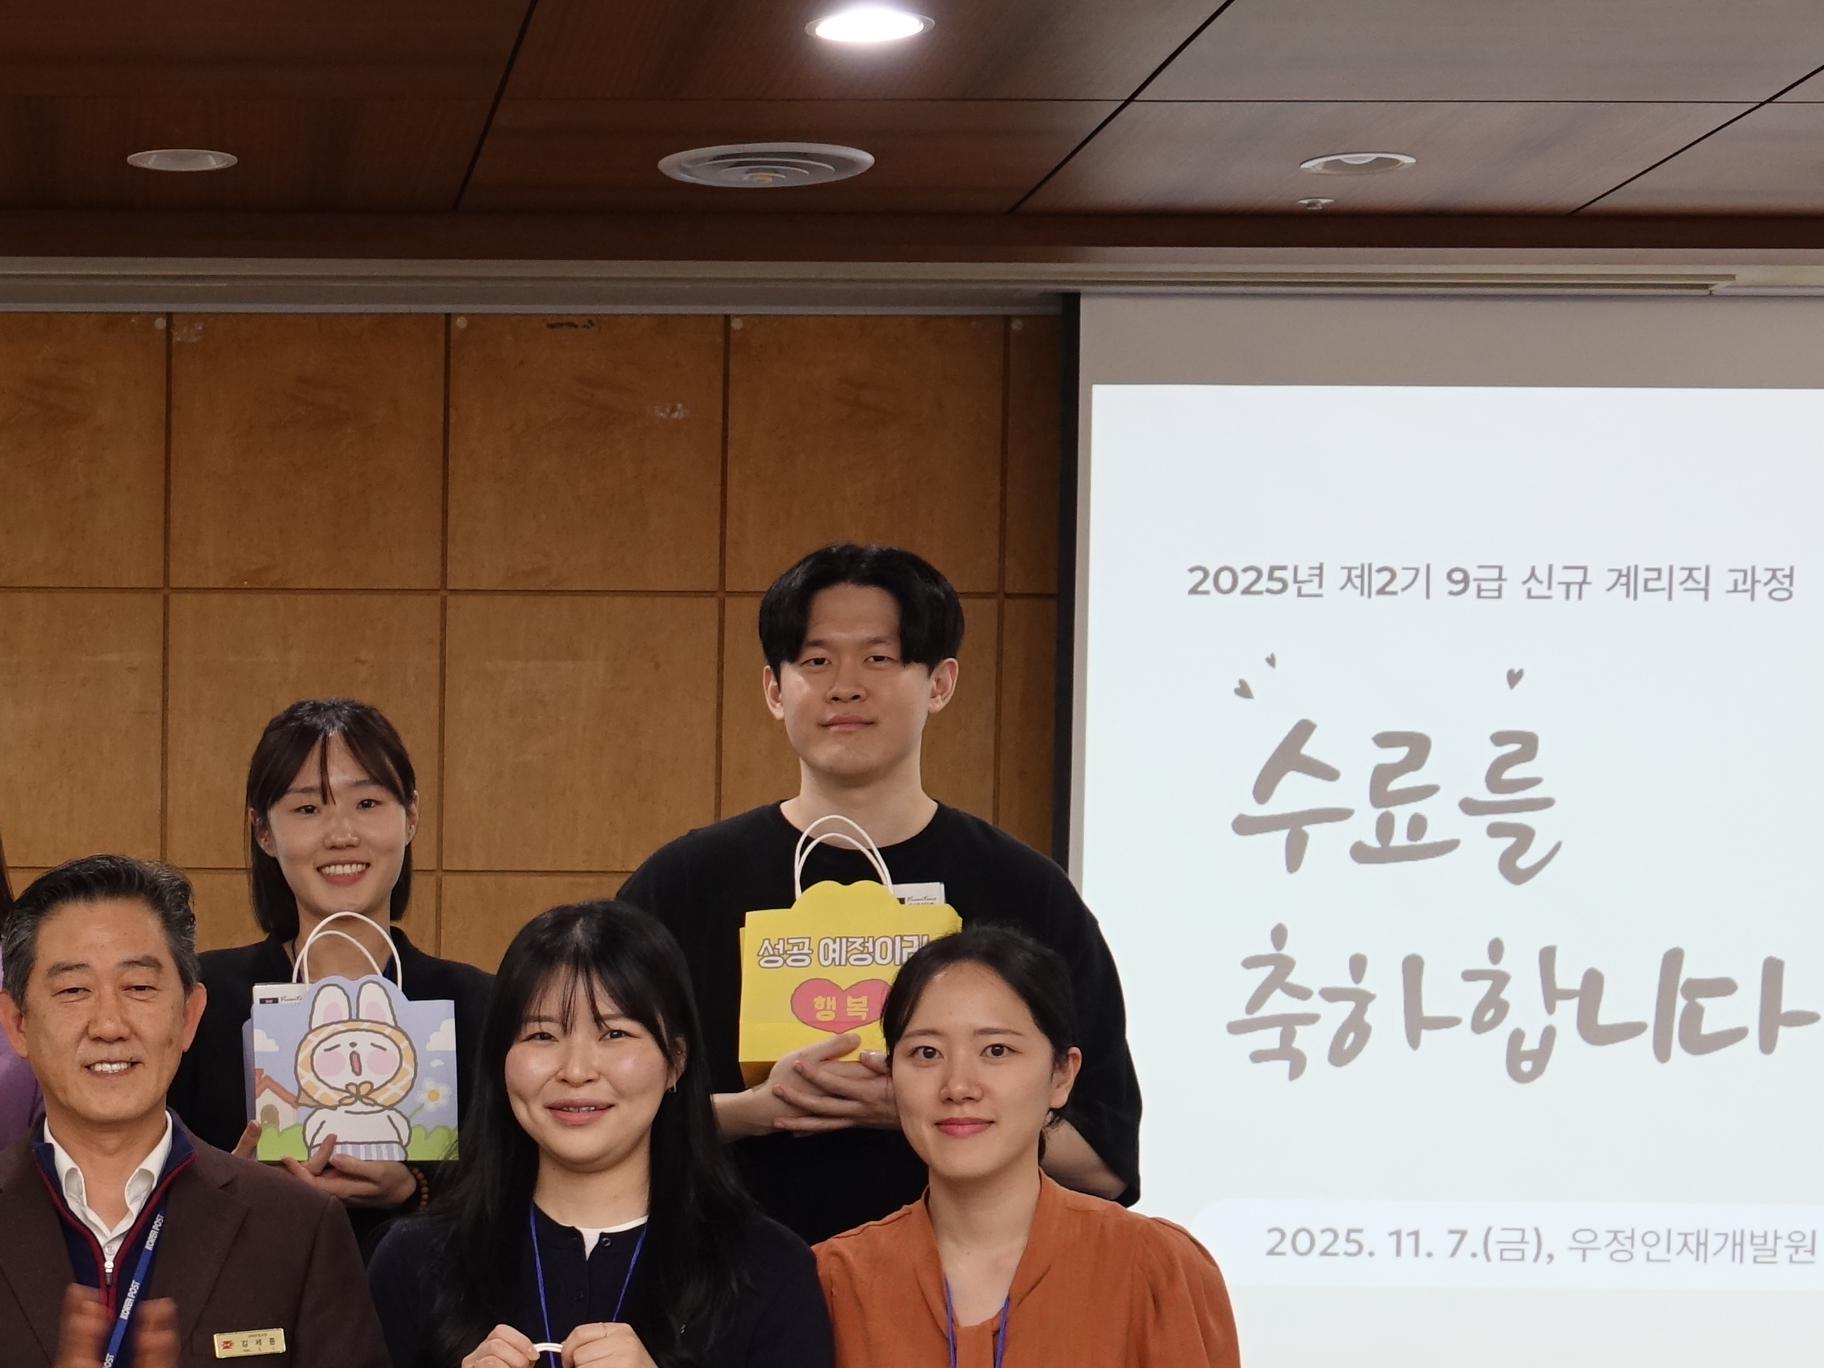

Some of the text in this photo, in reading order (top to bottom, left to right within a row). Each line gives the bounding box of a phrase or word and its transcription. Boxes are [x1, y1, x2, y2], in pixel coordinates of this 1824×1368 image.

[1187, 562, 1794, 602] 2025년 제2기 9급 신규 계리직 과정
[1231, 719, 1562, 886] 수료를
[757, 936, 814, 969] 성공
[1226, 923, 1821, 1084] 축하합니다
[152, 1213, 165, 1232] POST
[1266, 1227, 1375, 1257] 2025.
[1388, 1229, 1433, 1258] 11.
[1568, 1228, 1816, 1264] 우정인재개발원
[127, 1279, 141, 1299] POST
